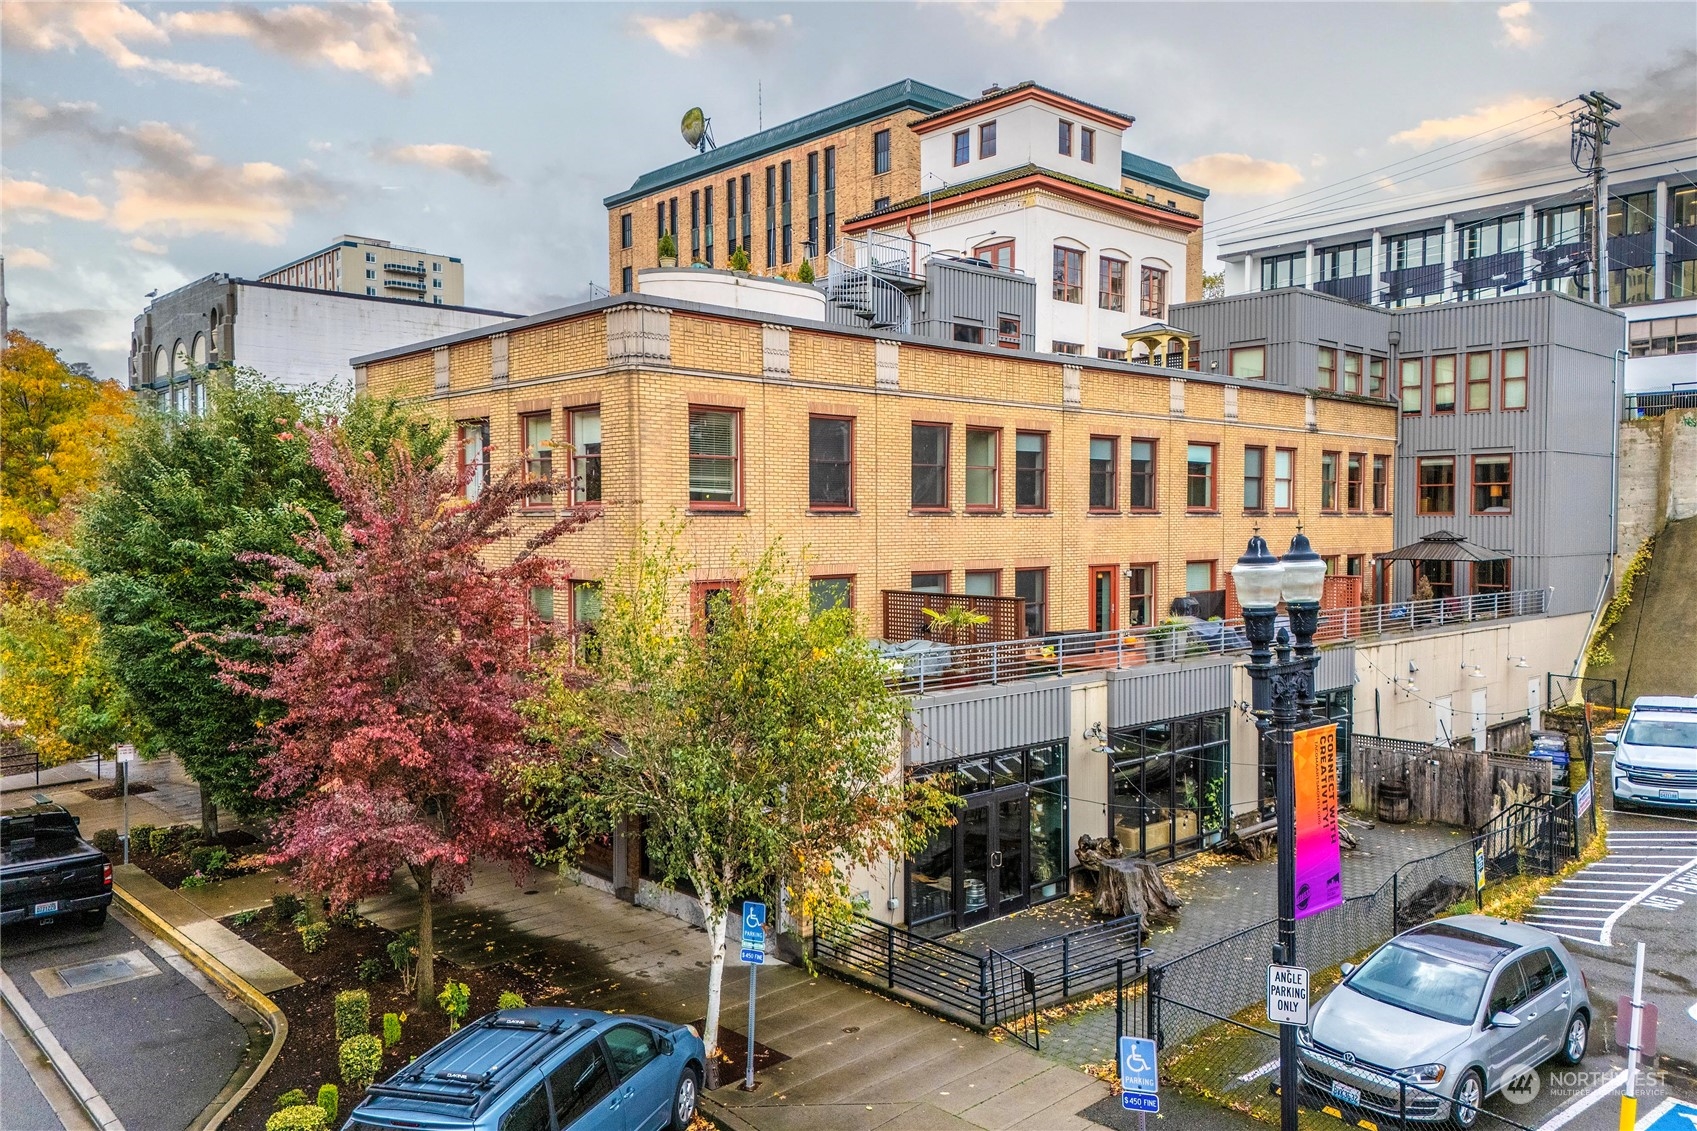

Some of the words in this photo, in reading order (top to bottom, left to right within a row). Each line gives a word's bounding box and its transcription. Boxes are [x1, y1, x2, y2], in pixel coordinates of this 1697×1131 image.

[1320, 735, 1330, 828] CREATIVITY!
[1640, 895, 1684, 910] NO
[1274, 972, 1302, 984] ANGLE
[1270, 984, 1306, 1000] PARKING
[1278, 1000, 1298, 1012] ONLY
[1126, 1076, 1154, 1086] PARKING
[1144, 1098, 1156, 1107] FINE
